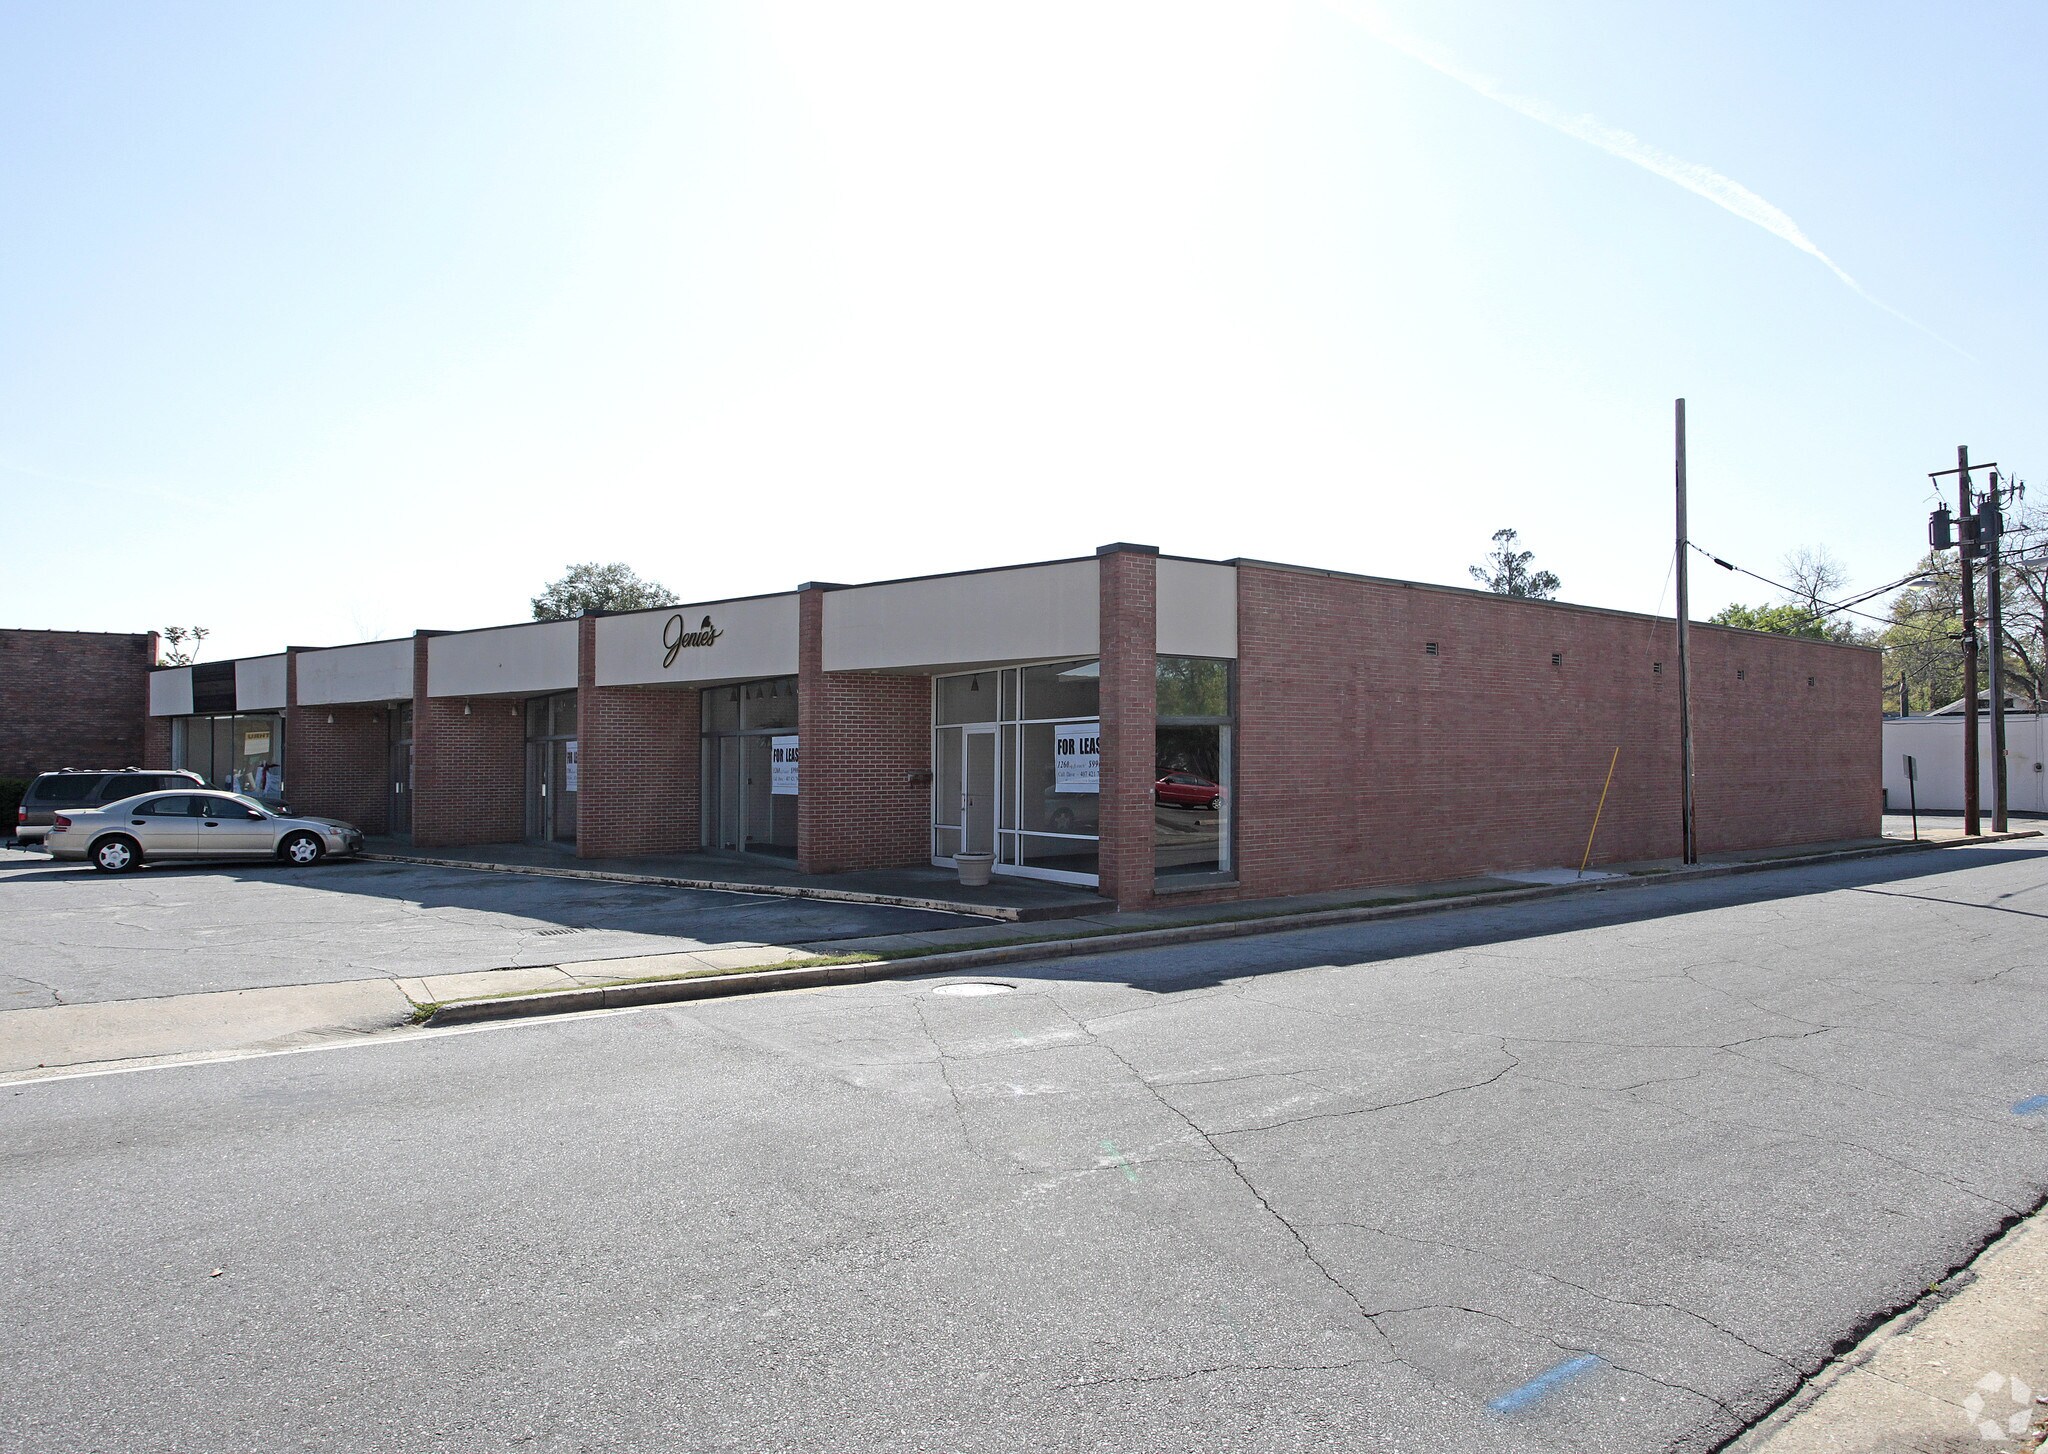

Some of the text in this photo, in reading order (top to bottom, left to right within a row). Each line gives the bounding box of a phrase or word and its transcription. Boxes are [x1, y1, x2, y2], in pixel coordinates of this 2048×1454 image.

[663, 614, 724, 668] Jenie's
[773, 748, 784, 763] FOR
[1057, 738, 1075, 756] FOR
